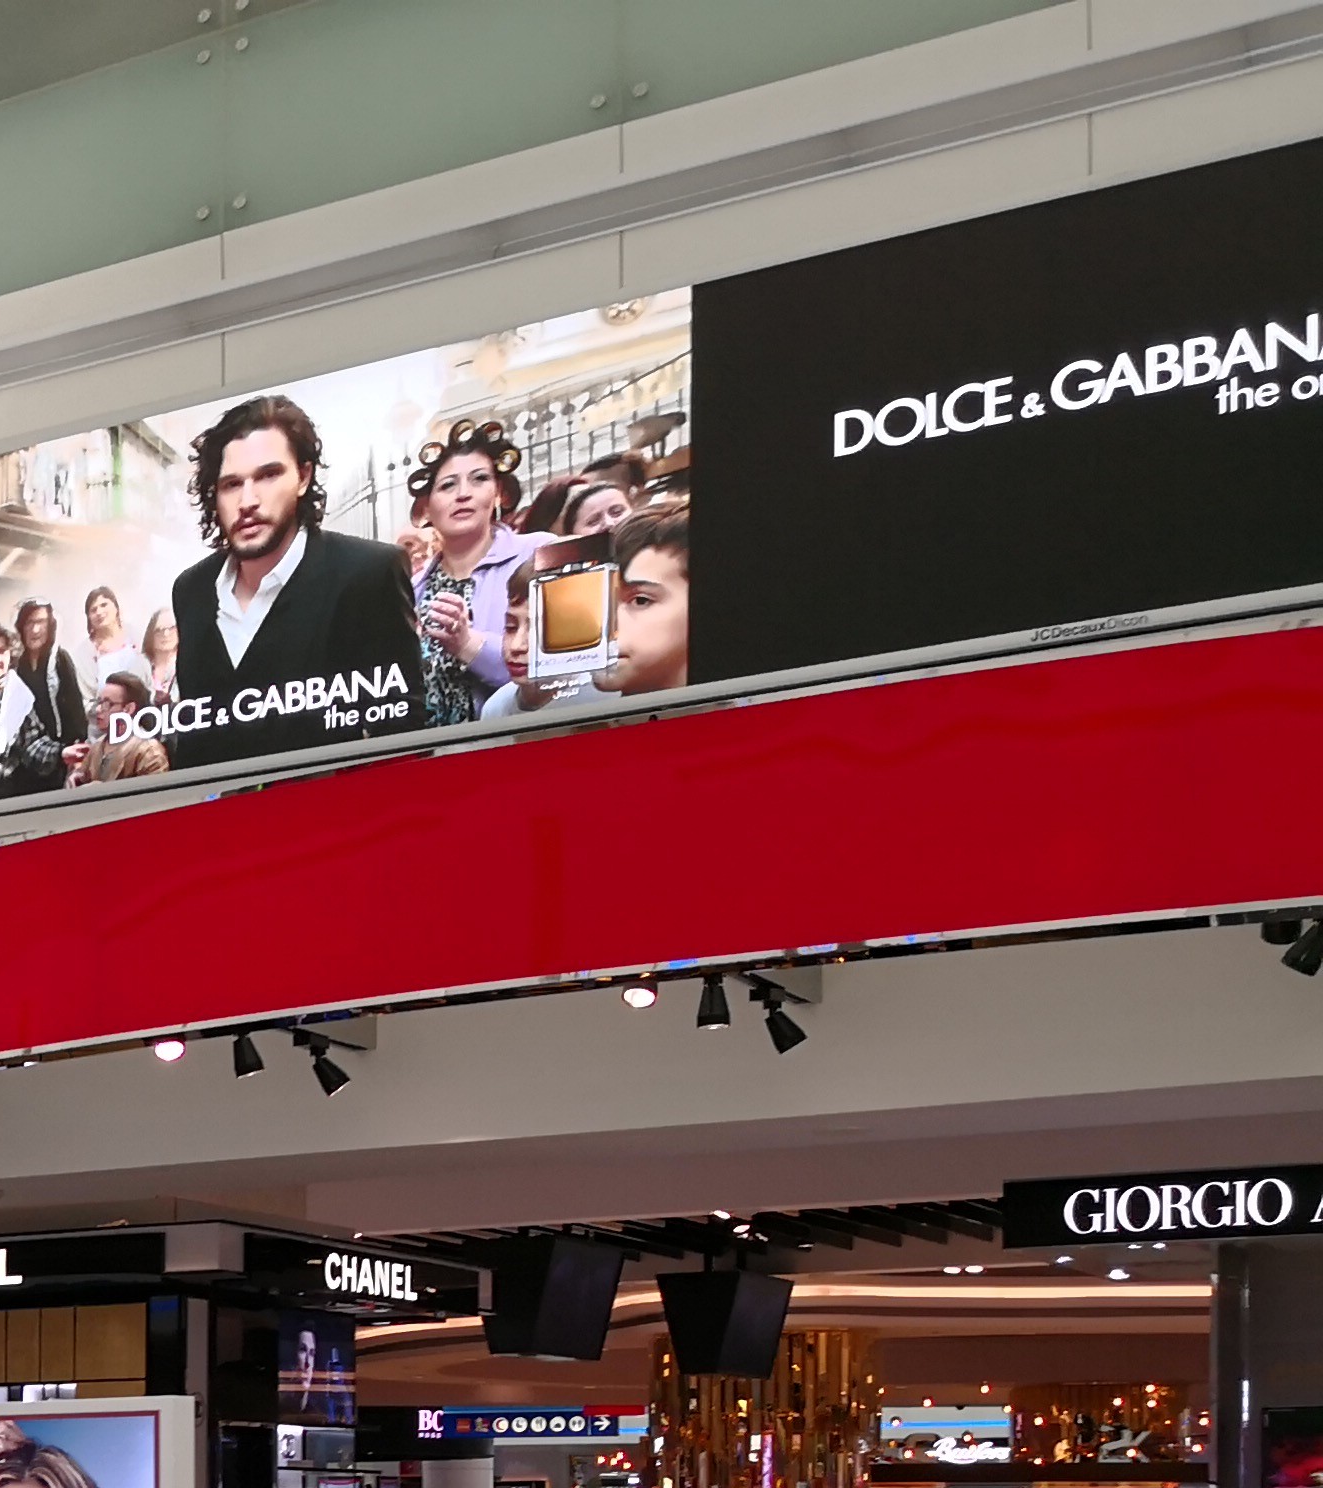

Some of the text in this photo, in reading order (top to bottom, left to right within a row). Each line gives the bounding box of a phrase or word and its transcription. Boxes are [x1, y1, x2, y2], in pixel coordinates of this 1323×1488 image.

[833, 312, 1323, 458] DOLCE & GABBAN
[1214, 373, 1323, 416] the o
[108, 662, 409, 745] DOLCE & GABBANA
[324, 699, 409, 731] the one
[1063, 1178, 1294, 1235] GIORGIO
[324, 1252, 418, 1301] CHANEL
